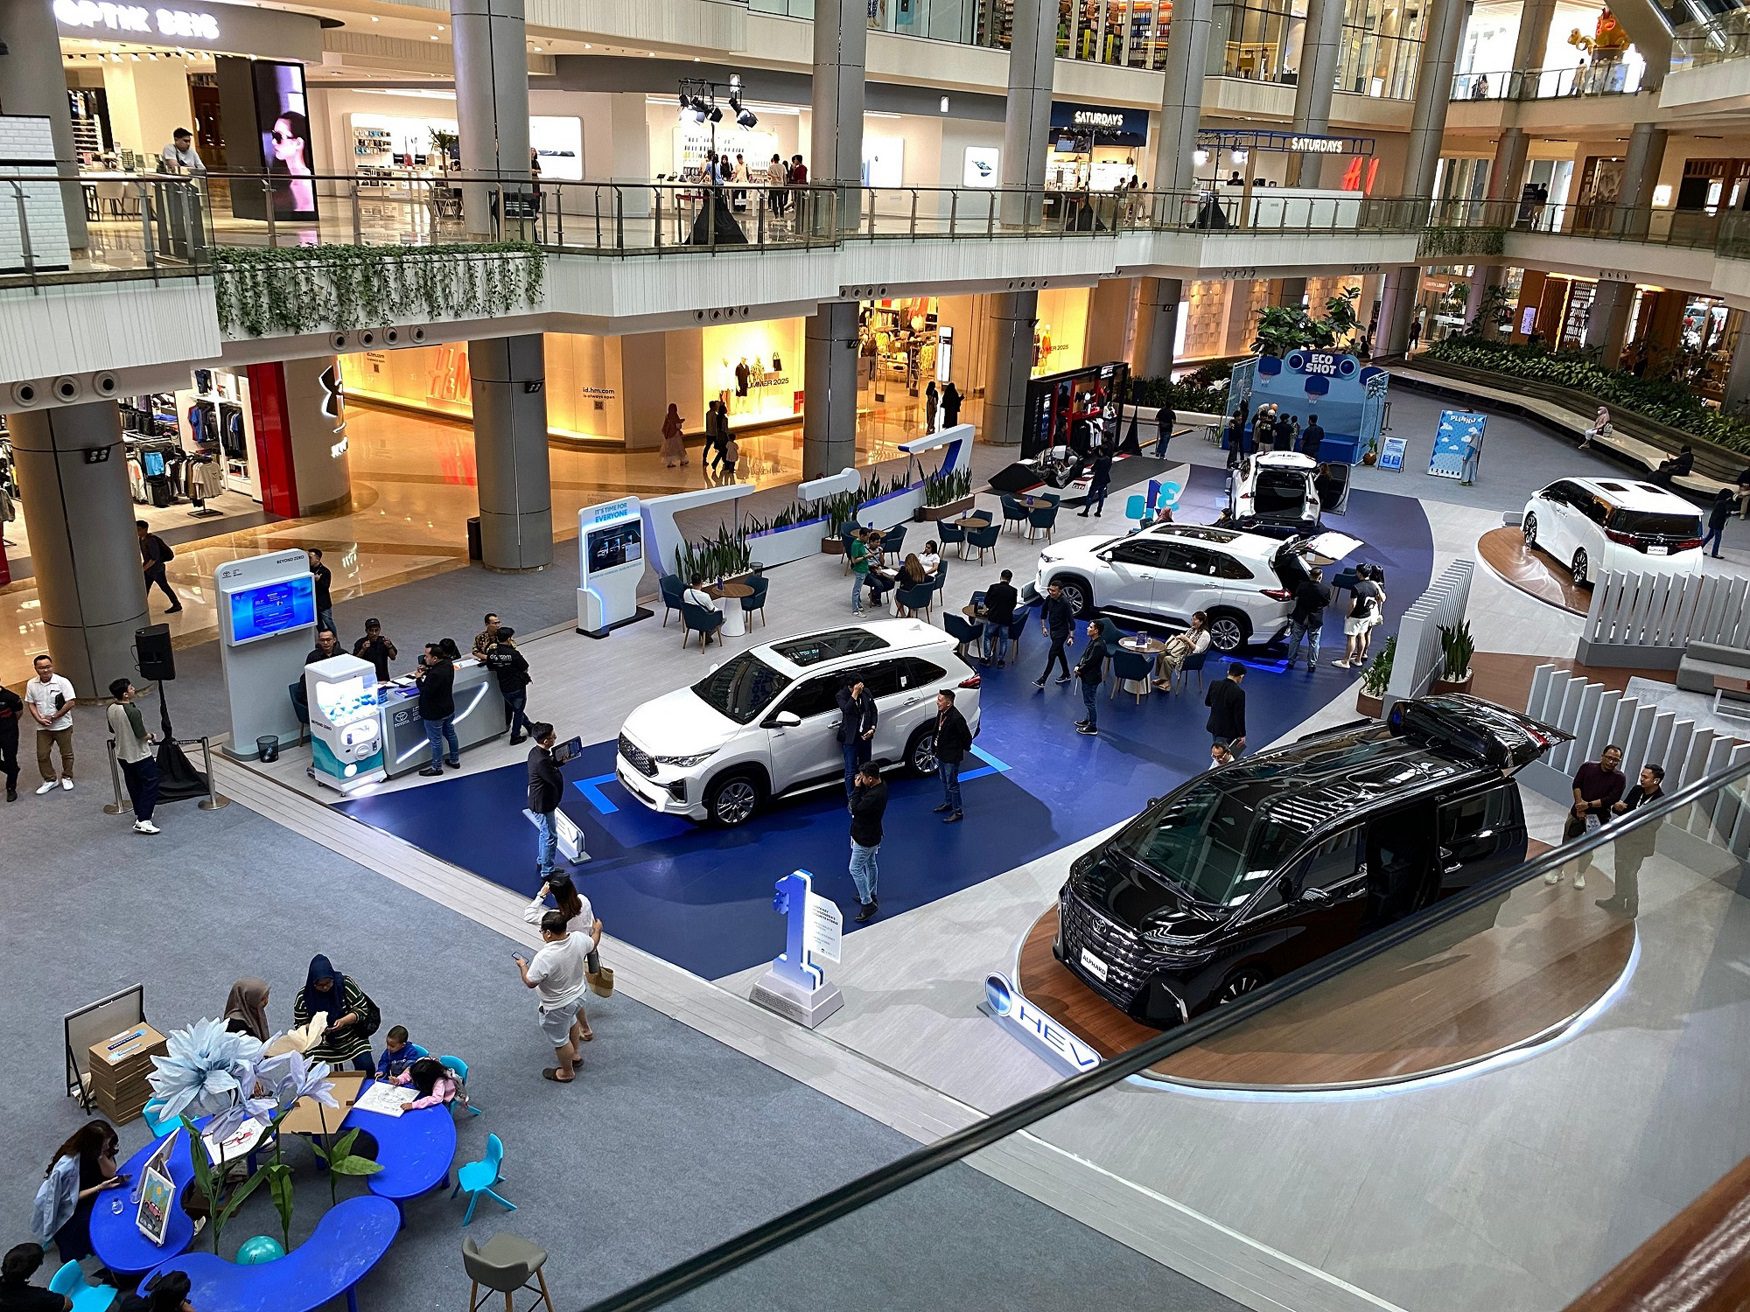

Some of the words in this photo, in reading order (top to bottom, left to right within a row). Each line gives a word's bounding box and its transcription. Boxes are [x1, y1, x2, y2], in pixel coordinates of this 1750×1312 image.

[1074, 110, 1124, 126] SATURDAYS
[1291, 137, 1343, 153] SATURDAYS
[1311, 353, 1334, 365] ECO
[1305, 362, 1337, 375] SHOT
[773, 378, 790, 386] 2025
[595, 507, 604, 516] IT'S
[604, 504, 616, 513] TIME
[617, 502, 628, 510] FOR
[595, 509, 628, 523] EVERYONE
[394, 719, 410, 728] TOYOTA
[1082, 954, 1106, 976] ALPHARD
[1020, 1005, 1095, 1066] HEV
